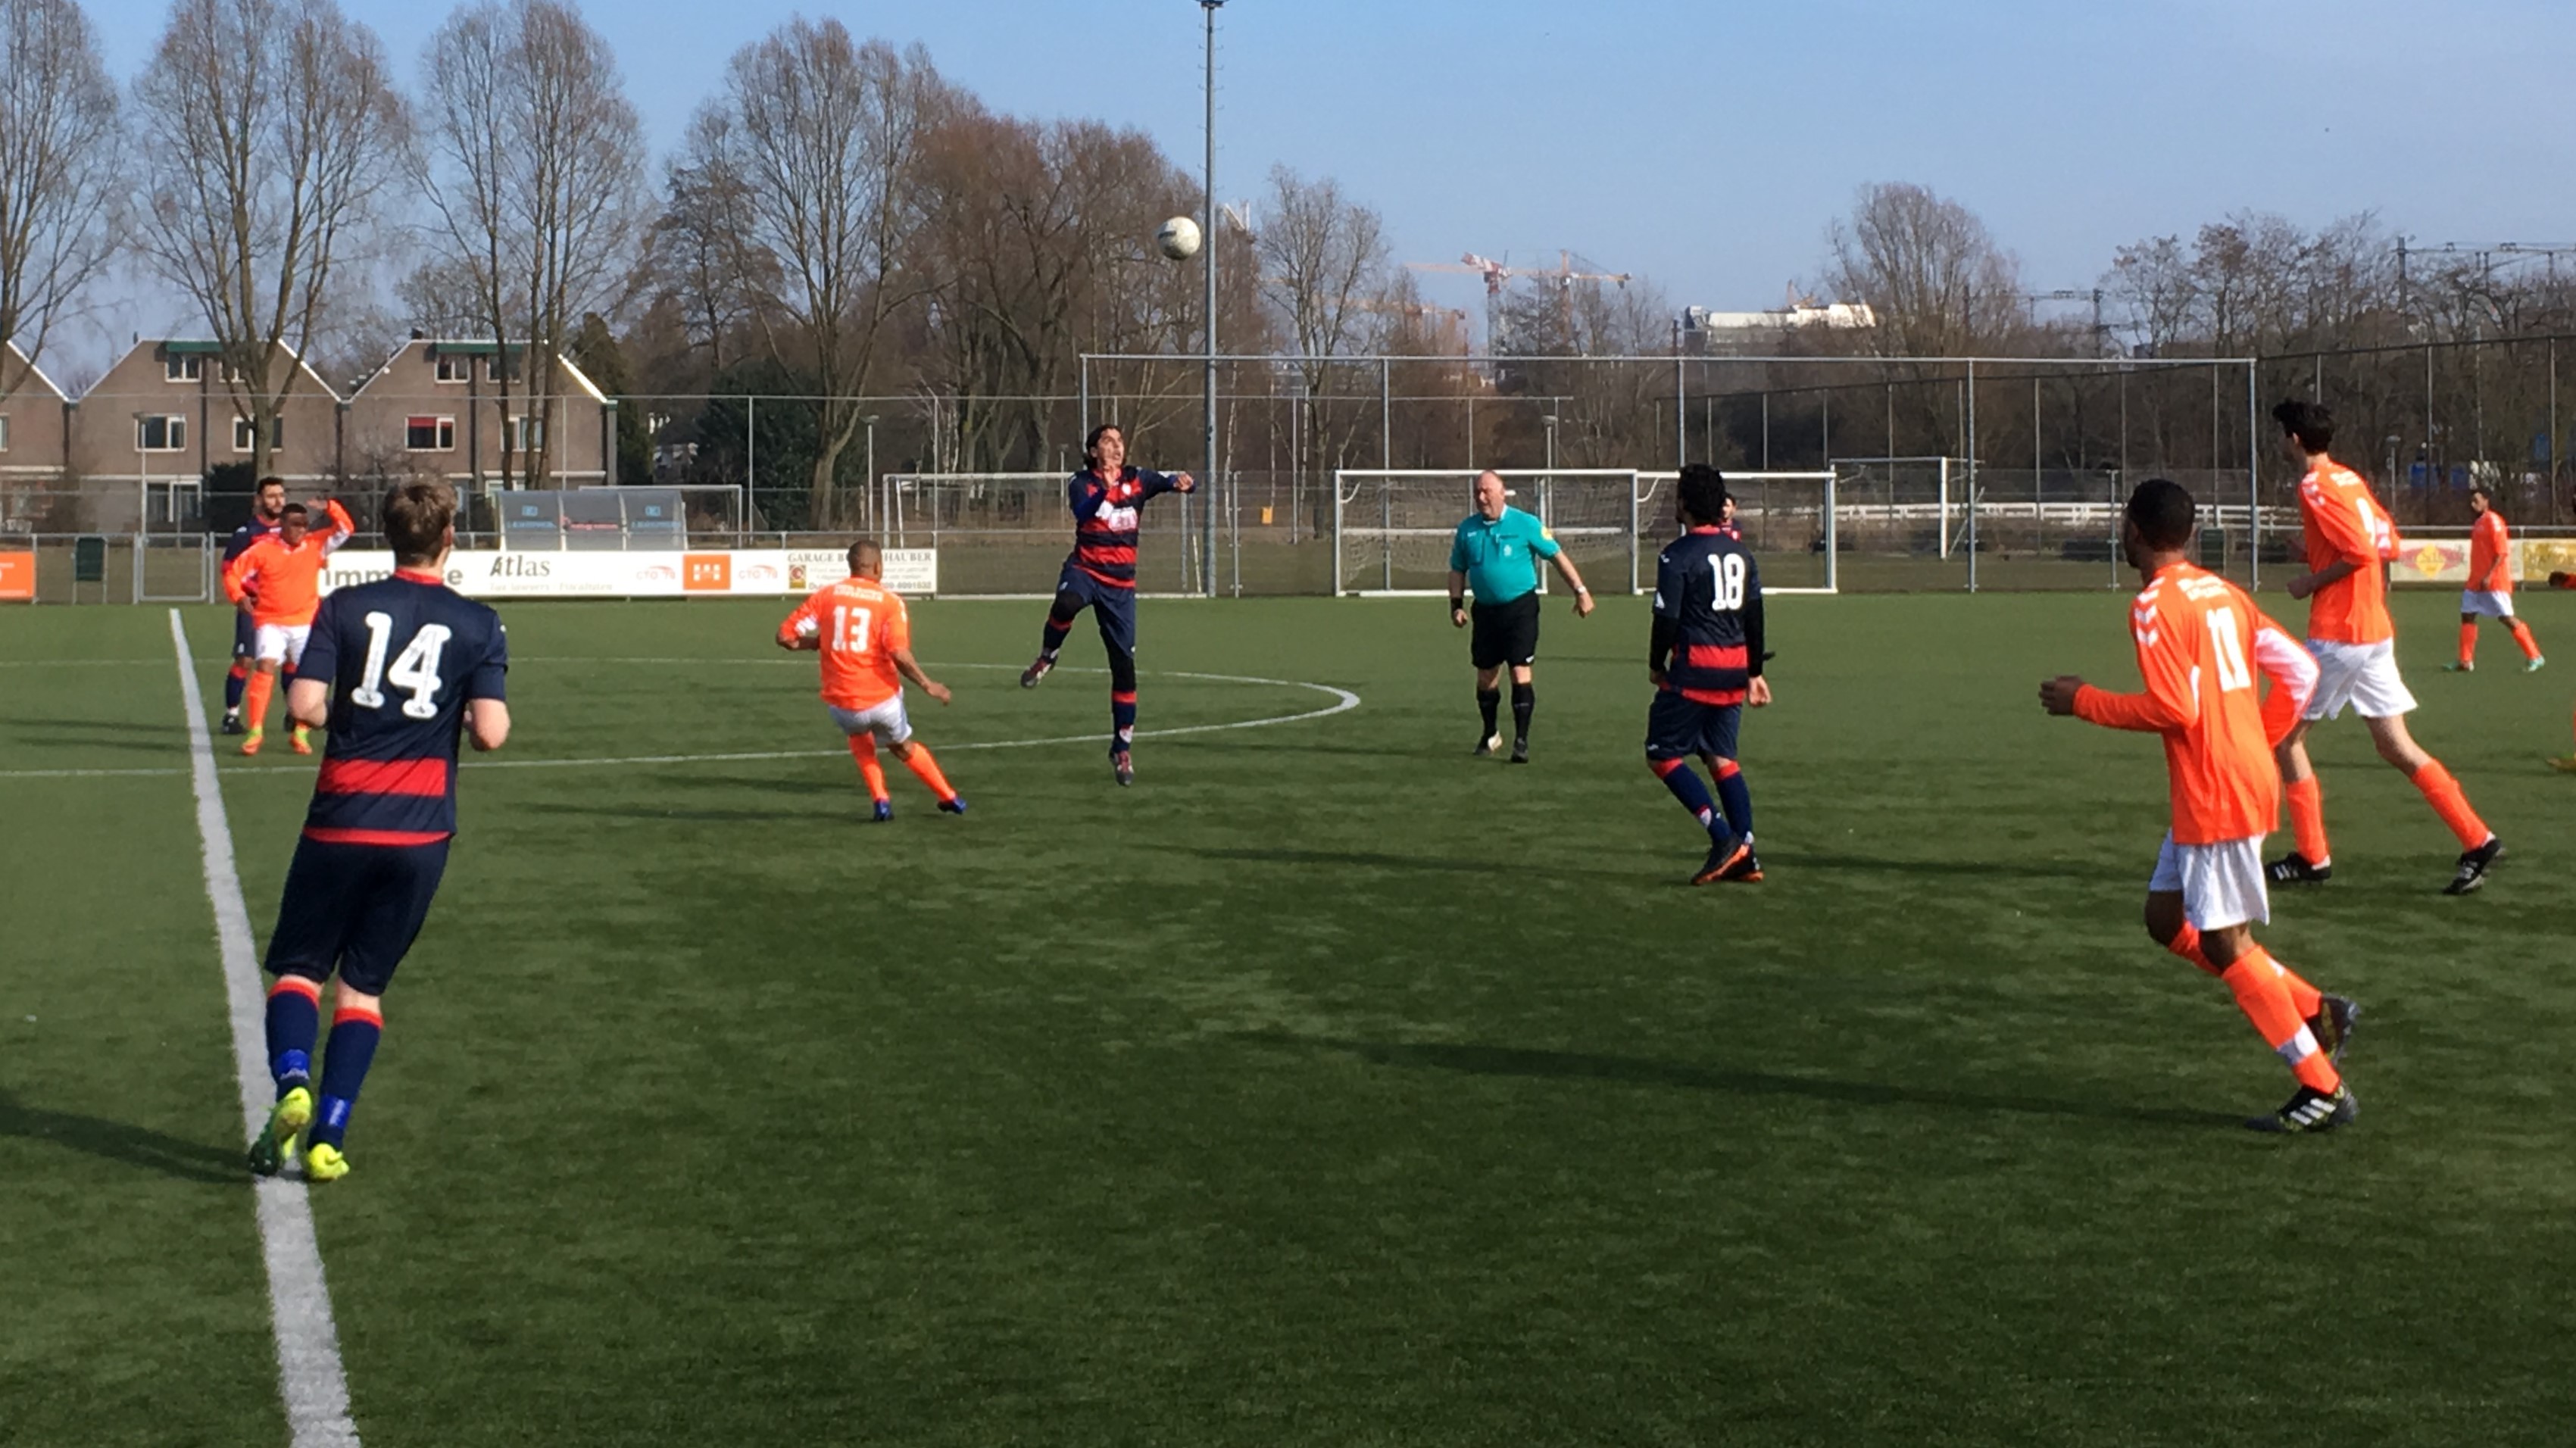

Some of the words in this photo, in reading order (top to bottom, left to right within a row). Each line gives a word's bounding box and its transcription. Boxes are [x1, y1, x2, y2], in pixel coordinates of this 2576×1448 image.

[489, 554, 551, 577] Atlas
[788, 552, 834, 562] GARAGE
[1707, 554, 1745, 610] 18
[832, 605, 871, 652] 13
[2206, 606, 2252, 692] 11
[351, 610, 452, 719] 14
